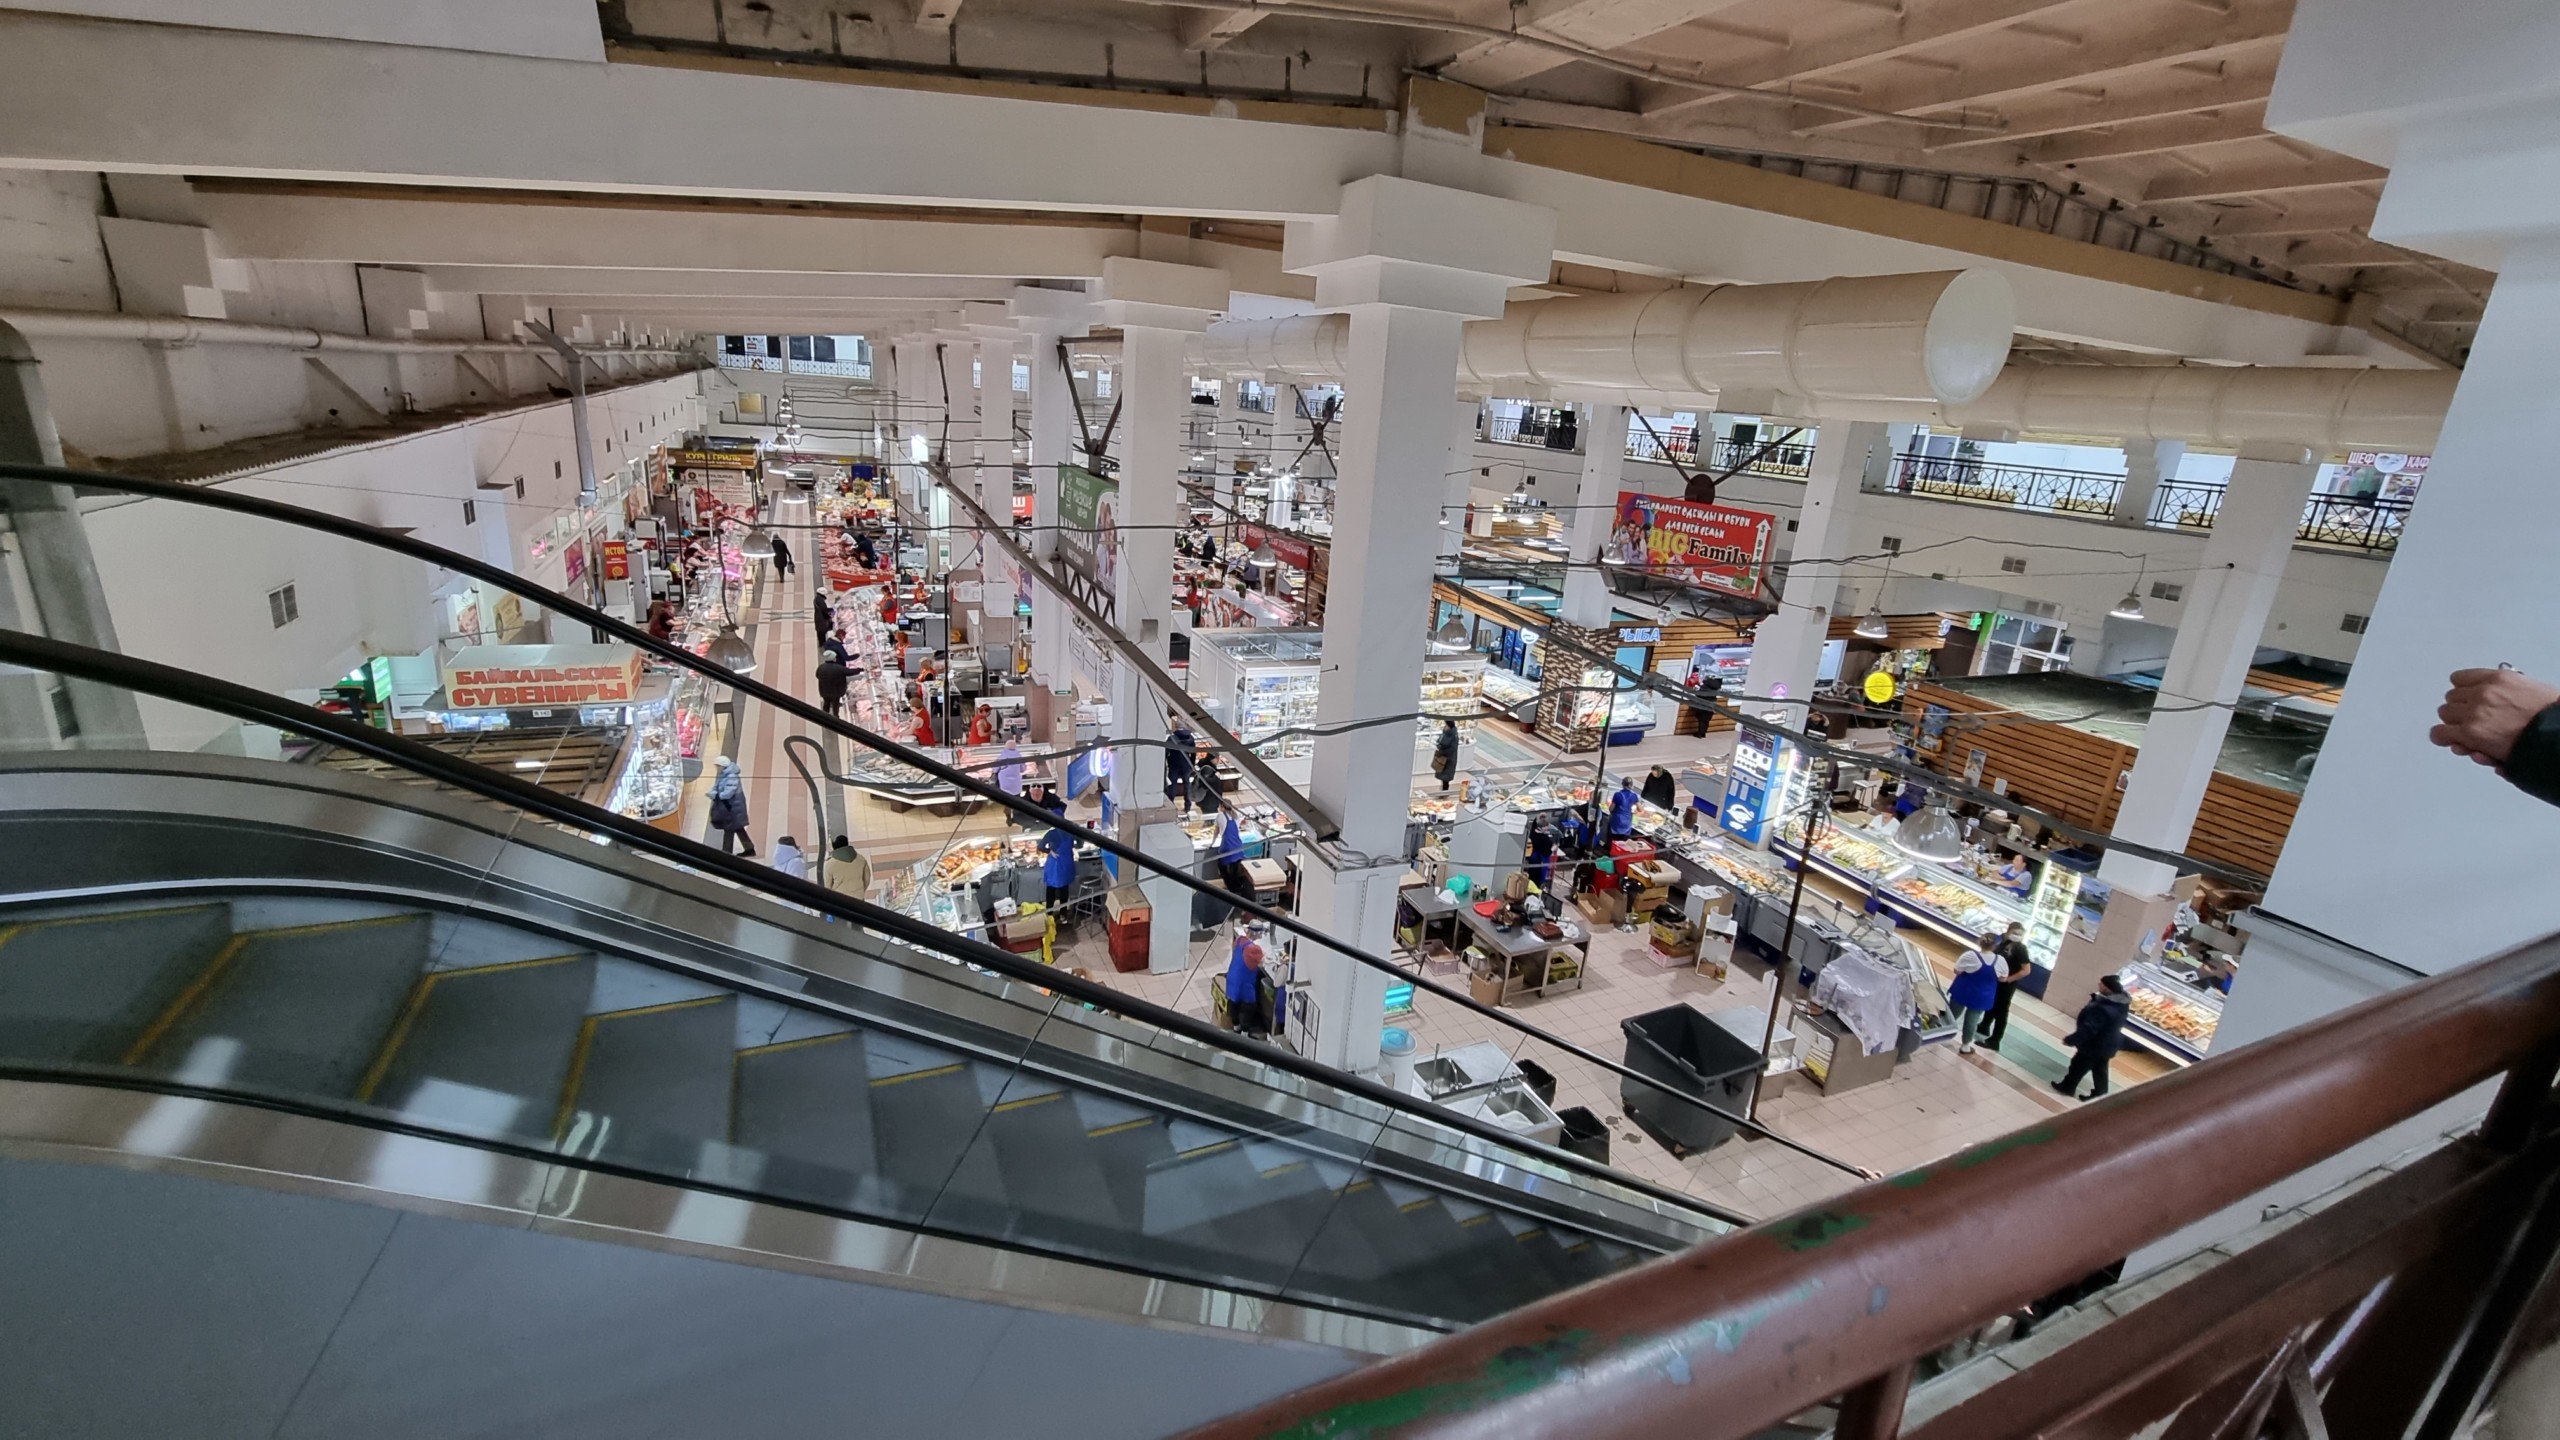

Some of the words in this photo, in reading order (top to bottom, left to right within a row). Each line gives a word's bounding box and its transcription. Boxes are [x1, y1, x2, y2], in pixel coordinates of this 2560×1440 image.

[712, 452, 741, 461] ГРИЛЬ
[2348, 451, 2376, 465] ШЕФ
[1681, 506, 1717, 522] ОДЕЖДЫ
[1717, 512, 1724, 523] И
[1724, 513, 1751, 528] ОБУВИ
[1665, 520, 1682, 531] ДЛЯ
[1682, 522, 1700, 535] ВСЕЙ
[1700, 526, 1725, 539] СЕМЬИ
[604, 546, 626, 556] ИСТОК
[1648, 528, 1689, 555] BIG
[1688, 538, 1752, 570] Family
[456, 667, 622, 685] БАЙКАЛЬСКИЕ
[452, 683, 627, 707] СУВЕНИРЫ
